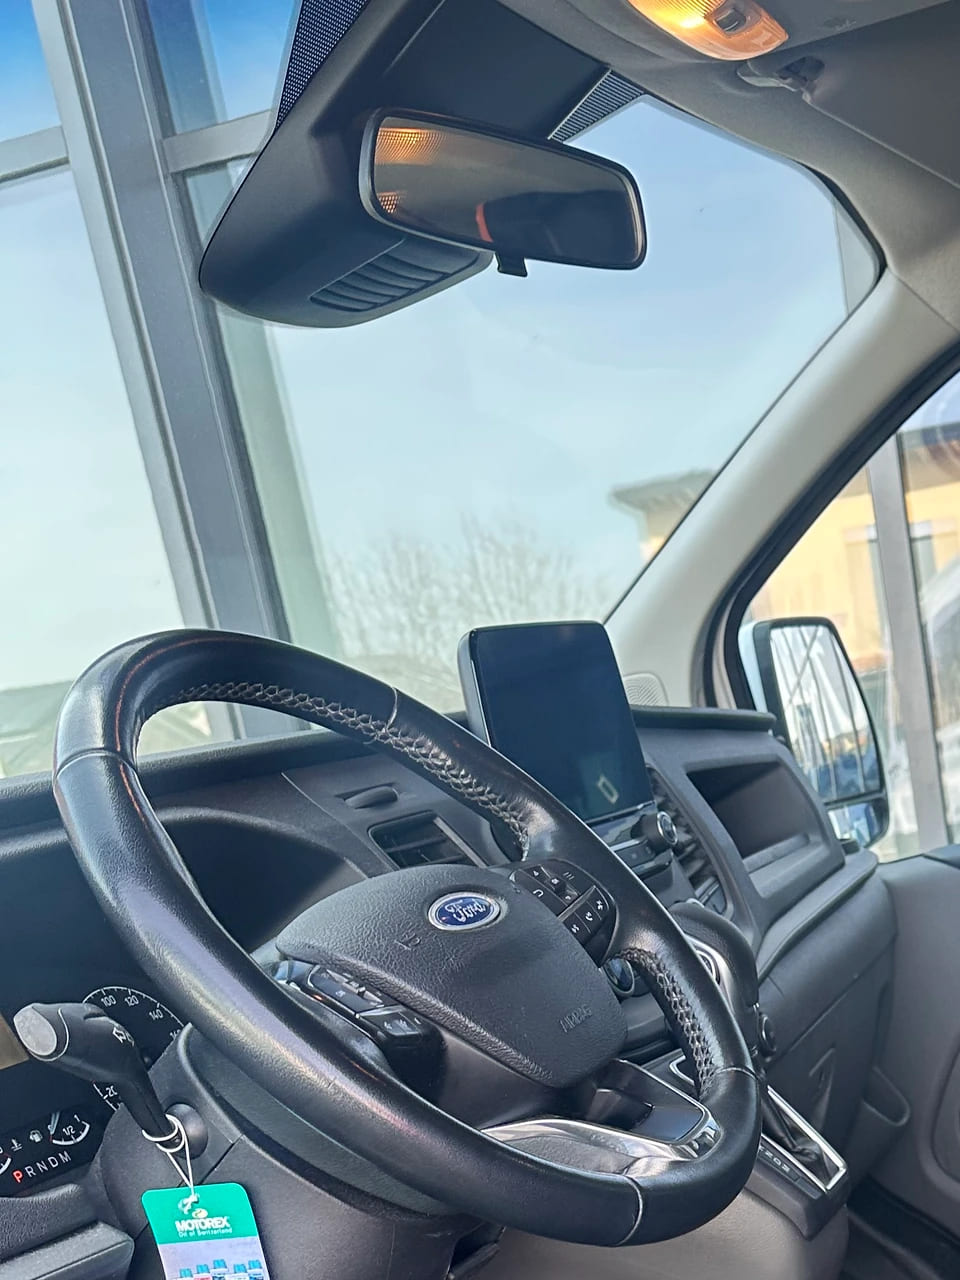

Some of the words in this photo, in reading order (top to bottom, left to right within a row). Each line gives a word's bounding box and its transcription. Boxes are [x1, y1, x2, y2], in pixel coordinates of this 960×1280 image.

[445, 898, 487, 922] Ford
[100, 995, 117, 1007] 100
[124, 995, 139, 1007] 120
[149, 1009, 163, 1020] 140
[12, 1170, 23, 1183] P
[25, 1165, 37, 1177] R
[36, 1160, 48, 1173] N
[47, 1156, 59, 1168] D
[58, 1150, 72, 1163] M
[175, 1216, 231, 1232] MOTOREX
